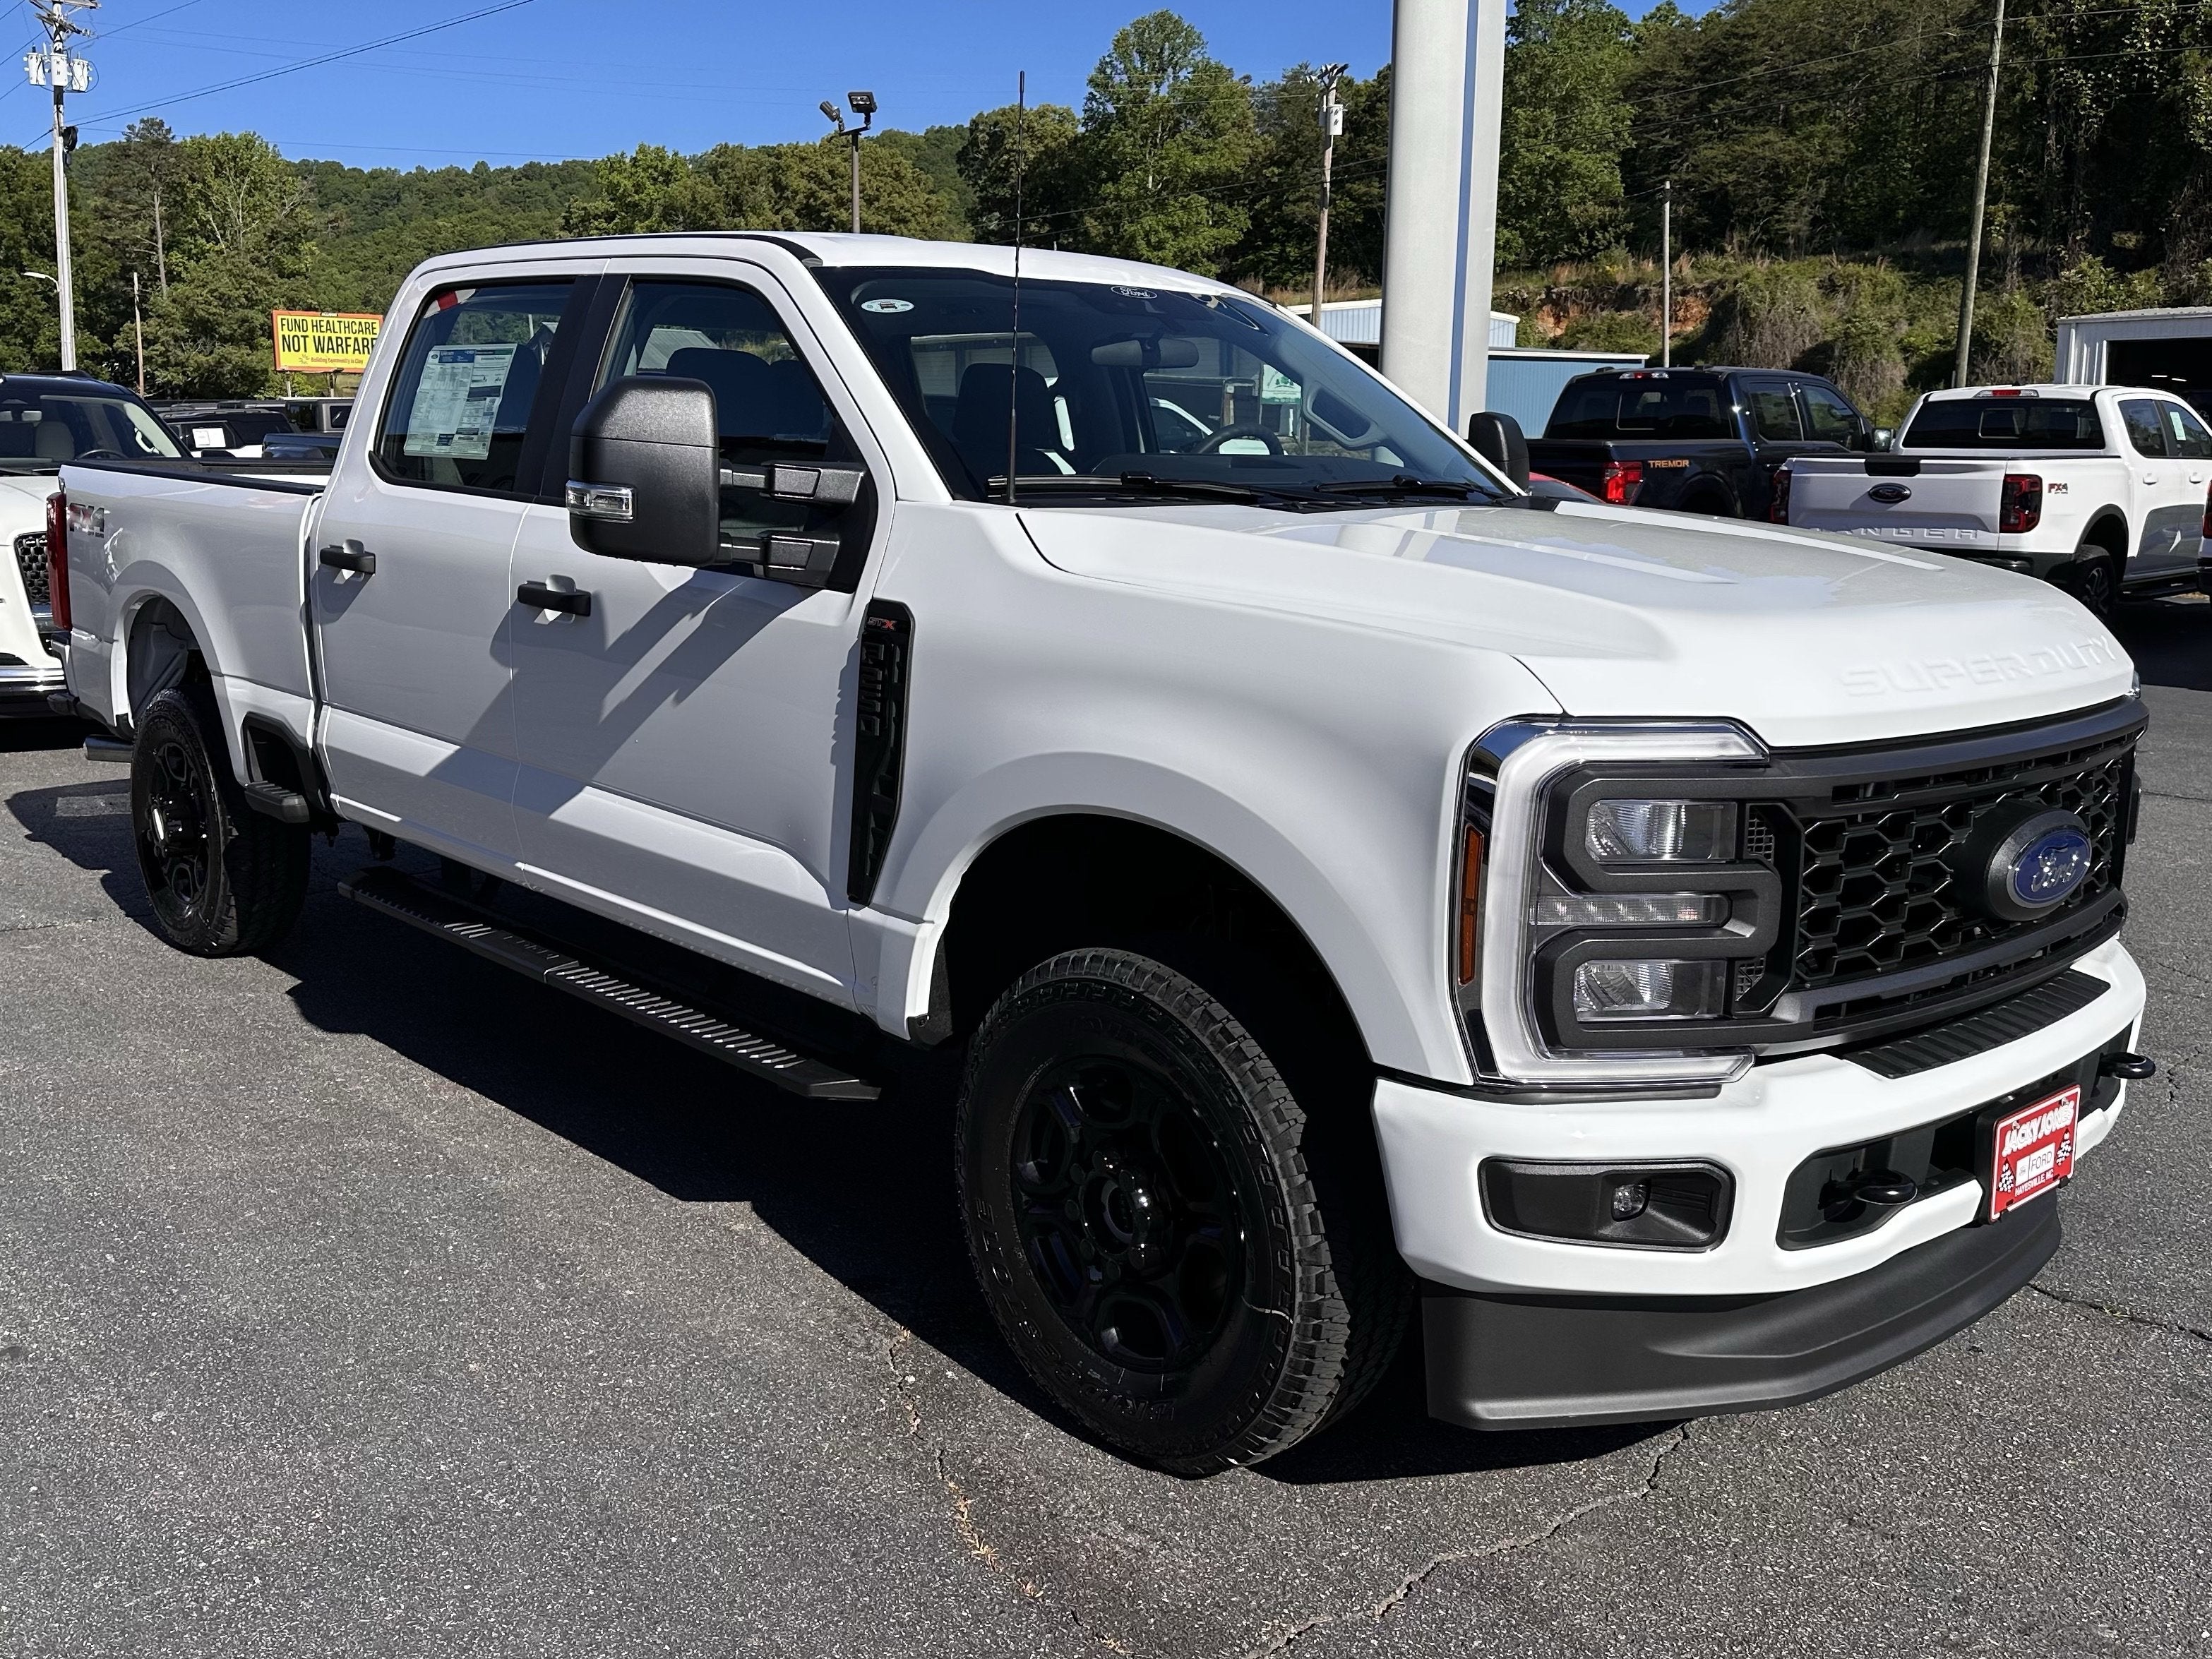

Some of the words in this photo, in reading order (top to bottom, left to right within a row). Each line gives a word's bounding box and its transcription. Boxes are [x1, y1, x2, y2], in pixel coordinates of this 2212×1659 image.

[1120, 283, 1150, 297] Ford
[280, 318, 308, 333] FUND
[311, 320, 378, 335] HEALTHCARE
[282, 335, 309, 352] NOT
[1648, 460, 1690, 468] TREMOR
[2048, 483, 2068, 493] FX4
[70, 503, 104, 532] FX4
[868, 617, 897, 631] STX
[1838, 652, 2034, 697] SUPER
[2029, 635, 2117, 675] DUTY
[2031, 842, 2078, 893] Ford
[2002, 1115, 2042, 1157] JACKY
[2038, 1101, 2075, 1139] JONES
[2031, 1151, 2052, 1172] FORD
